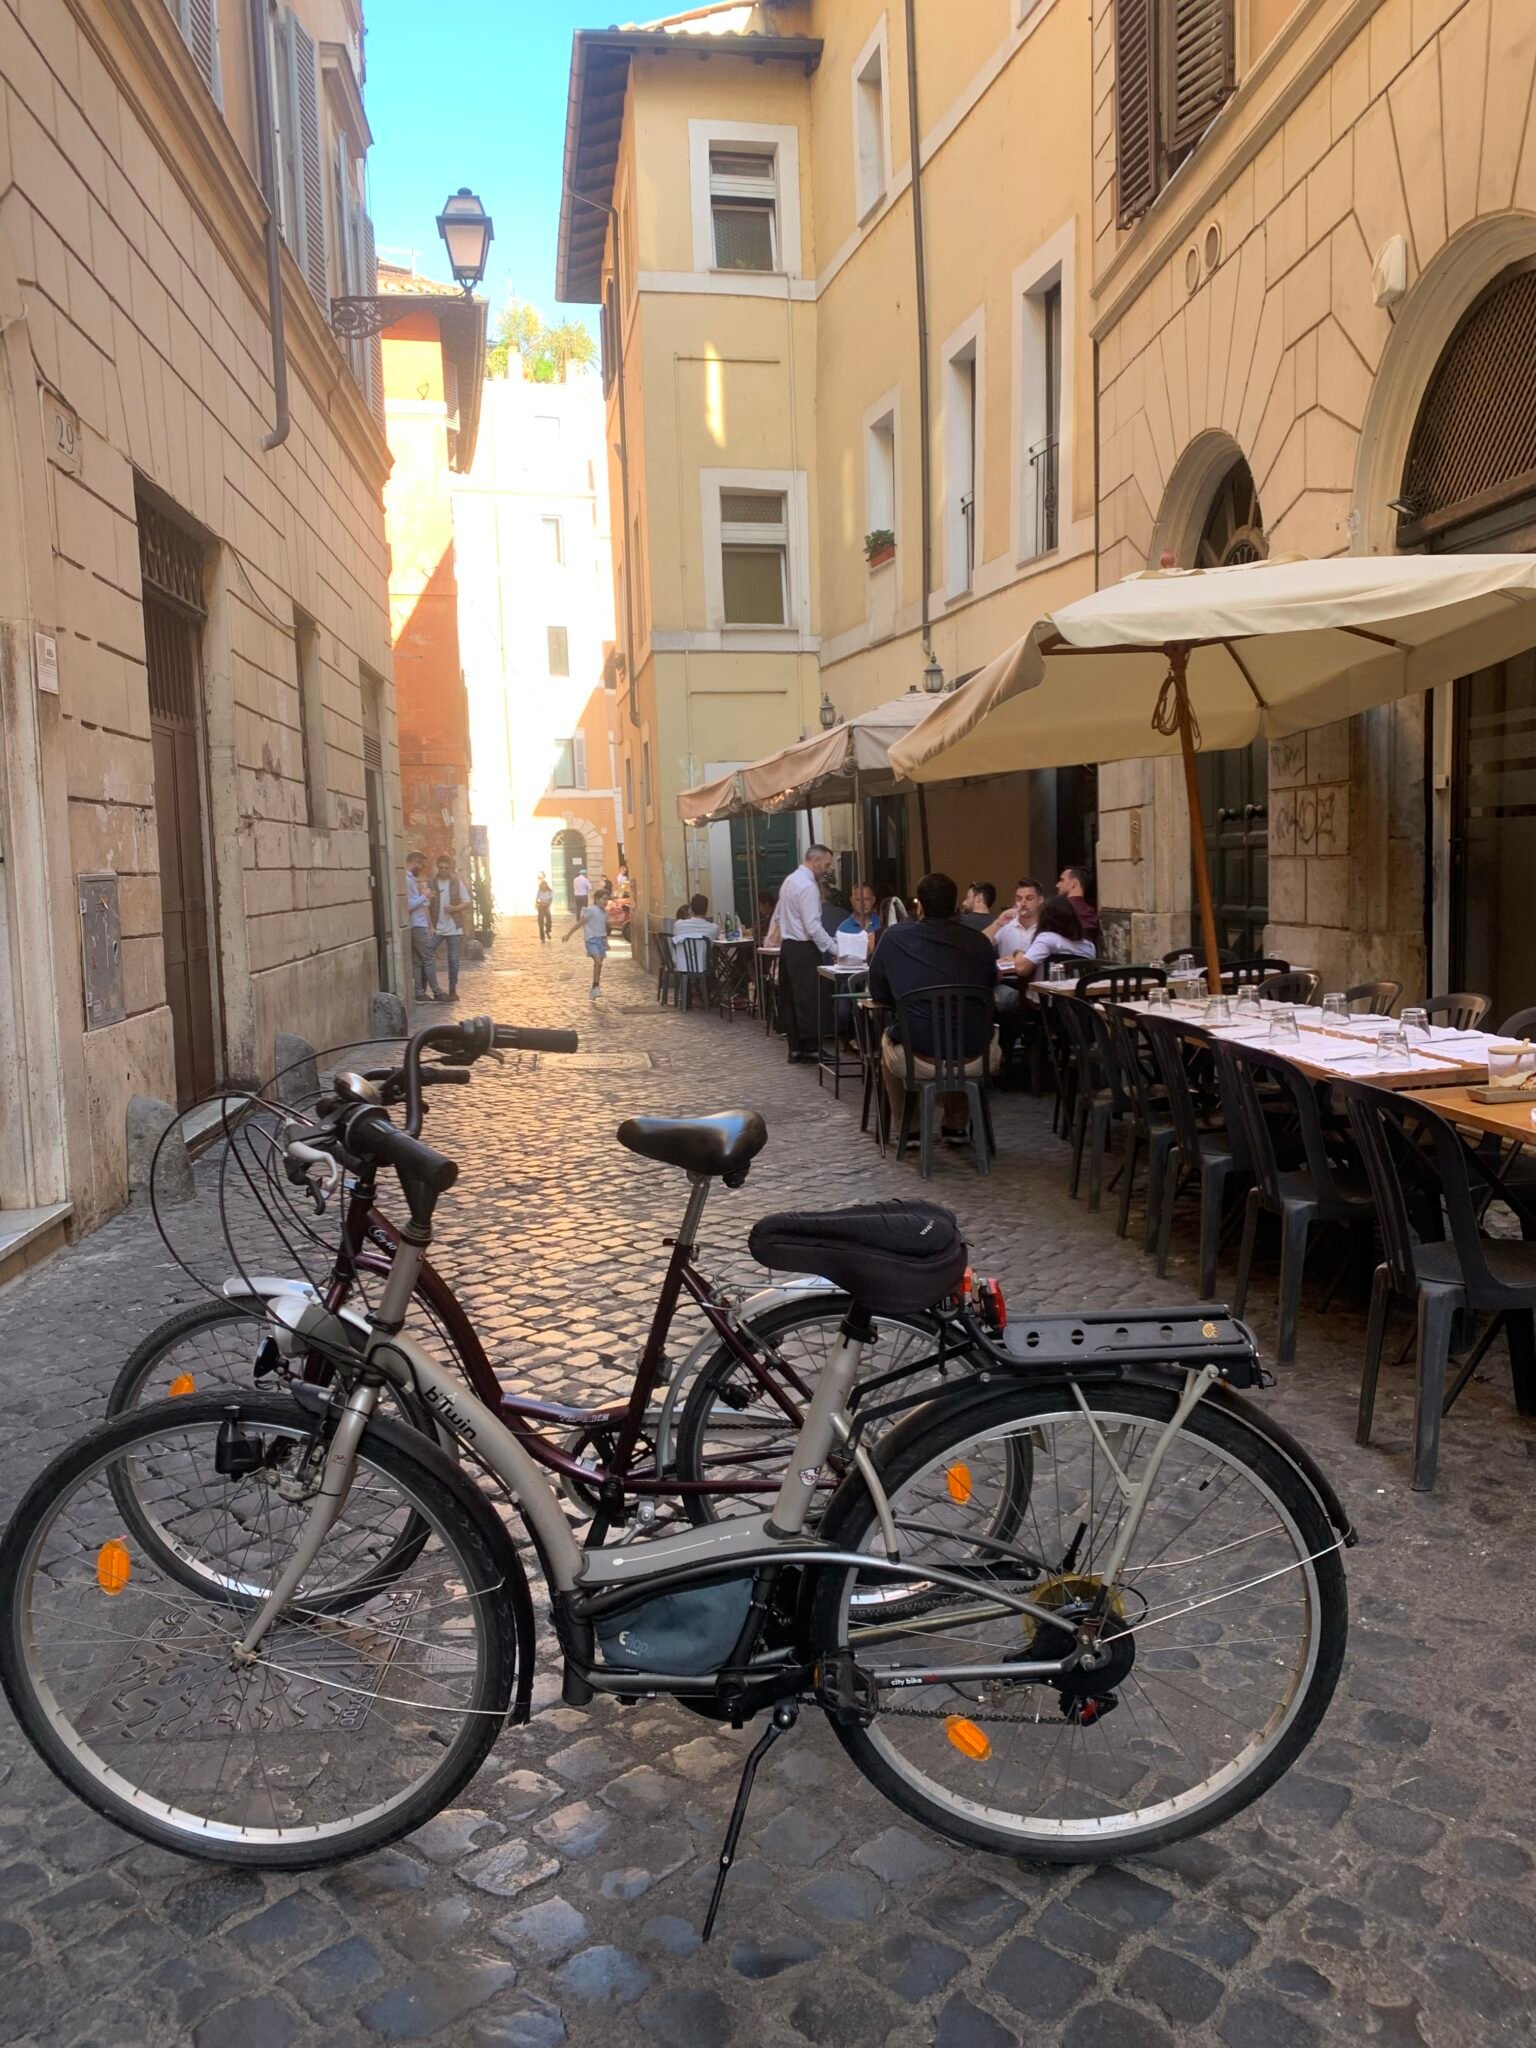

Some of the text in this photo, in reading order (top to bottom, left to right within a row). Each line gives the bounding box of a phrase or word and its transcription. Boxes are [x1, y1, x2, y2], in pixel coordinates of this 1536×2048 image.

[55, 414, 75, 456] 29
[891, 1677, 922, 1686] city bike
